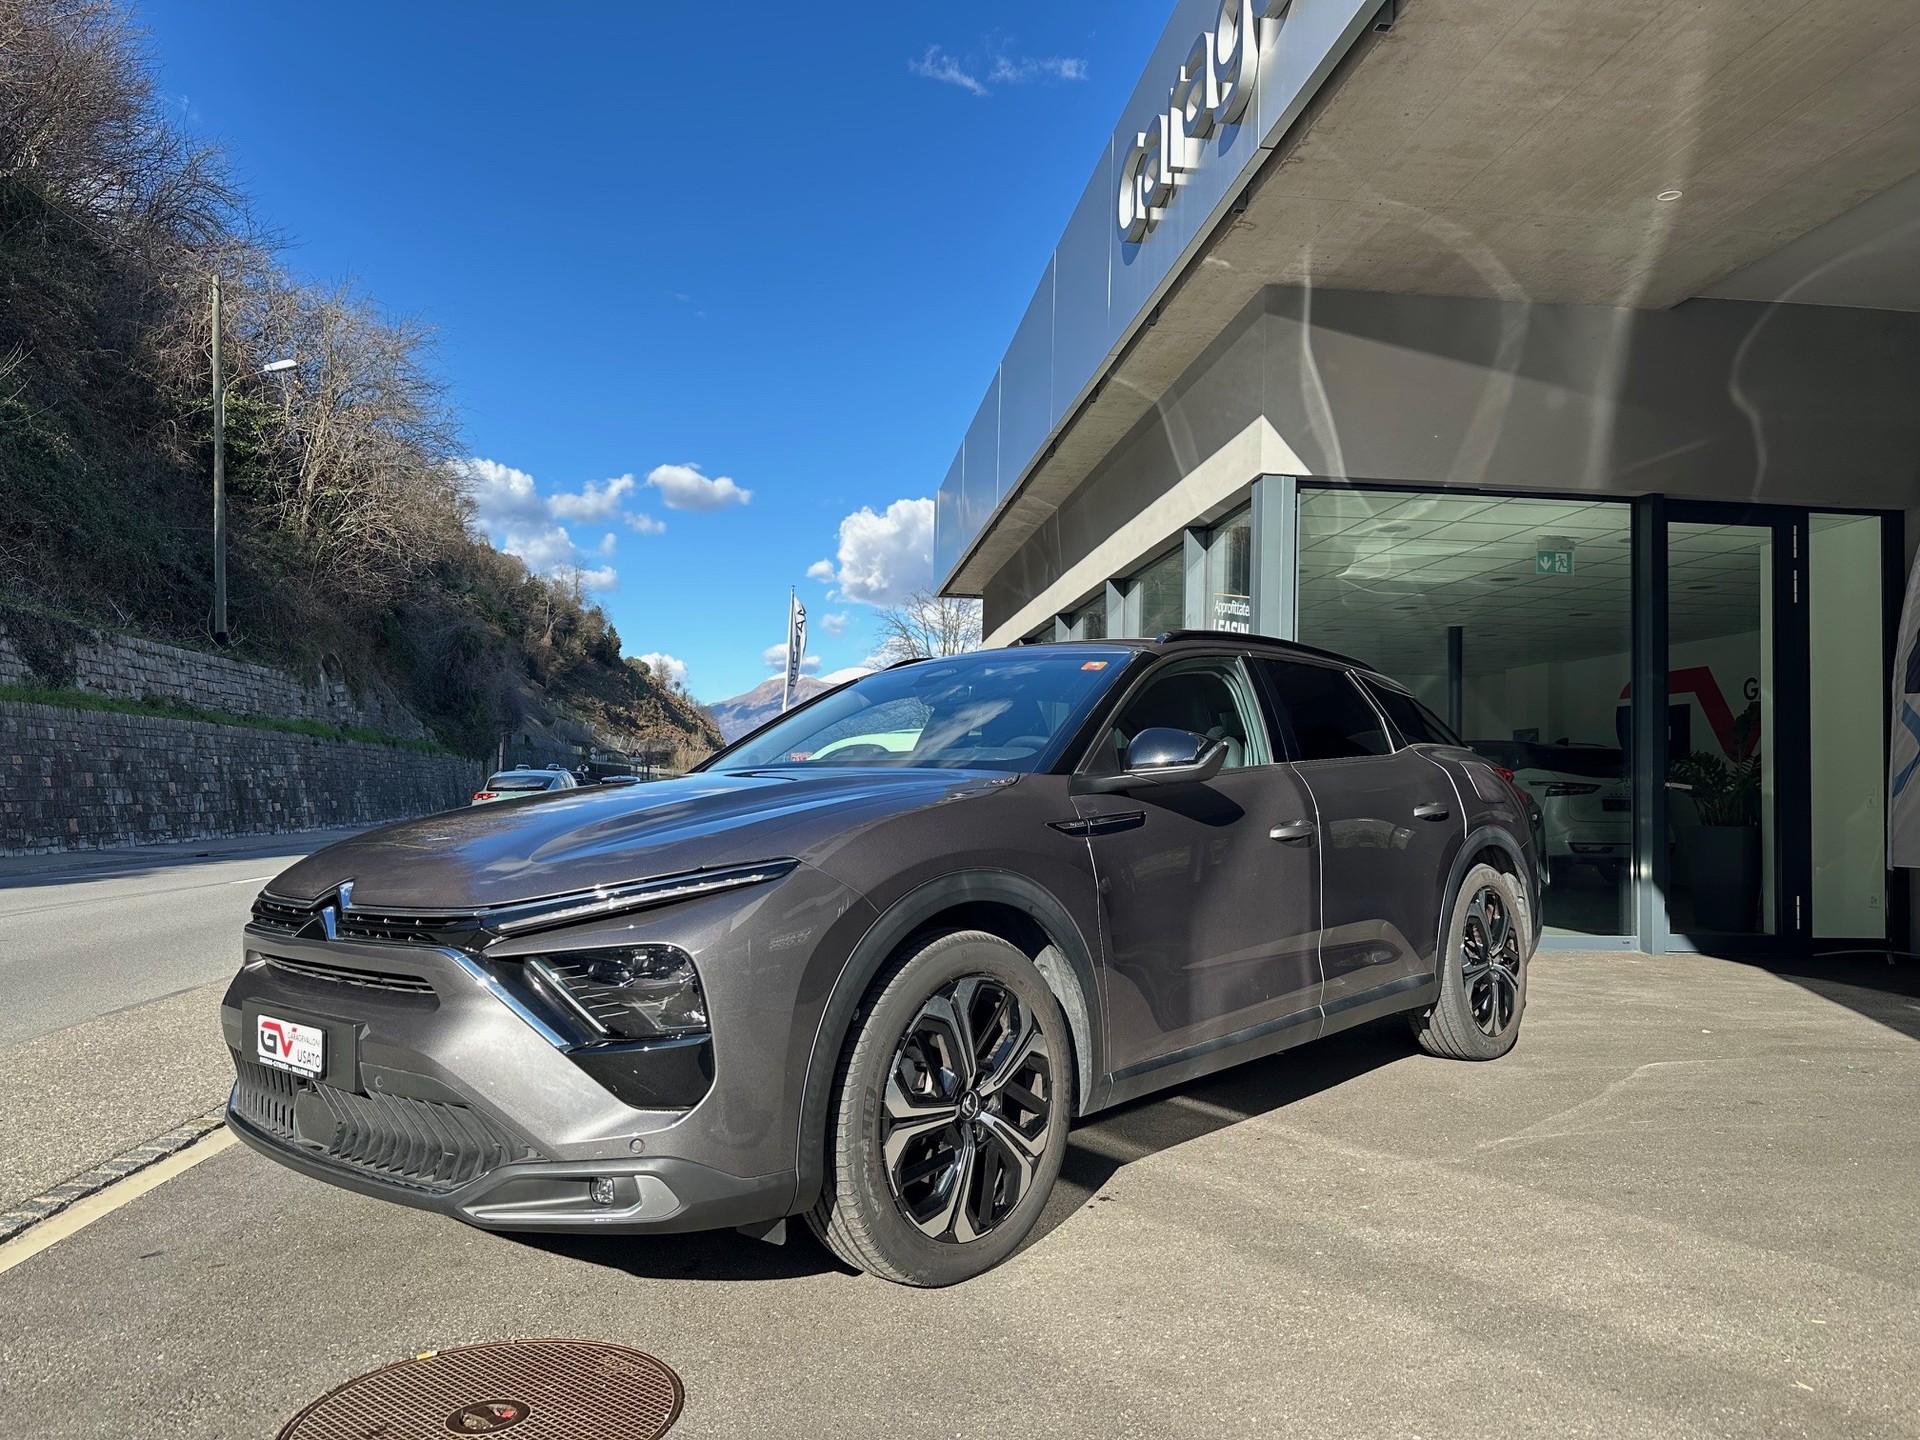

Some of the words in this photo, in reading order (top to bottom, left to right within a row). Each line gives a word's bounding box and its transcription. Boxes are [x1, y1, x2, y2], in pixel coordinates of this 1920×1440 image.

[1117, 0, 1293, 243] Garag
[1214, 599, 1251, 617] Approfittate
[1213, 618, 1250, 634] LEASIN
[297, 1049, 321, 1068] USATO
